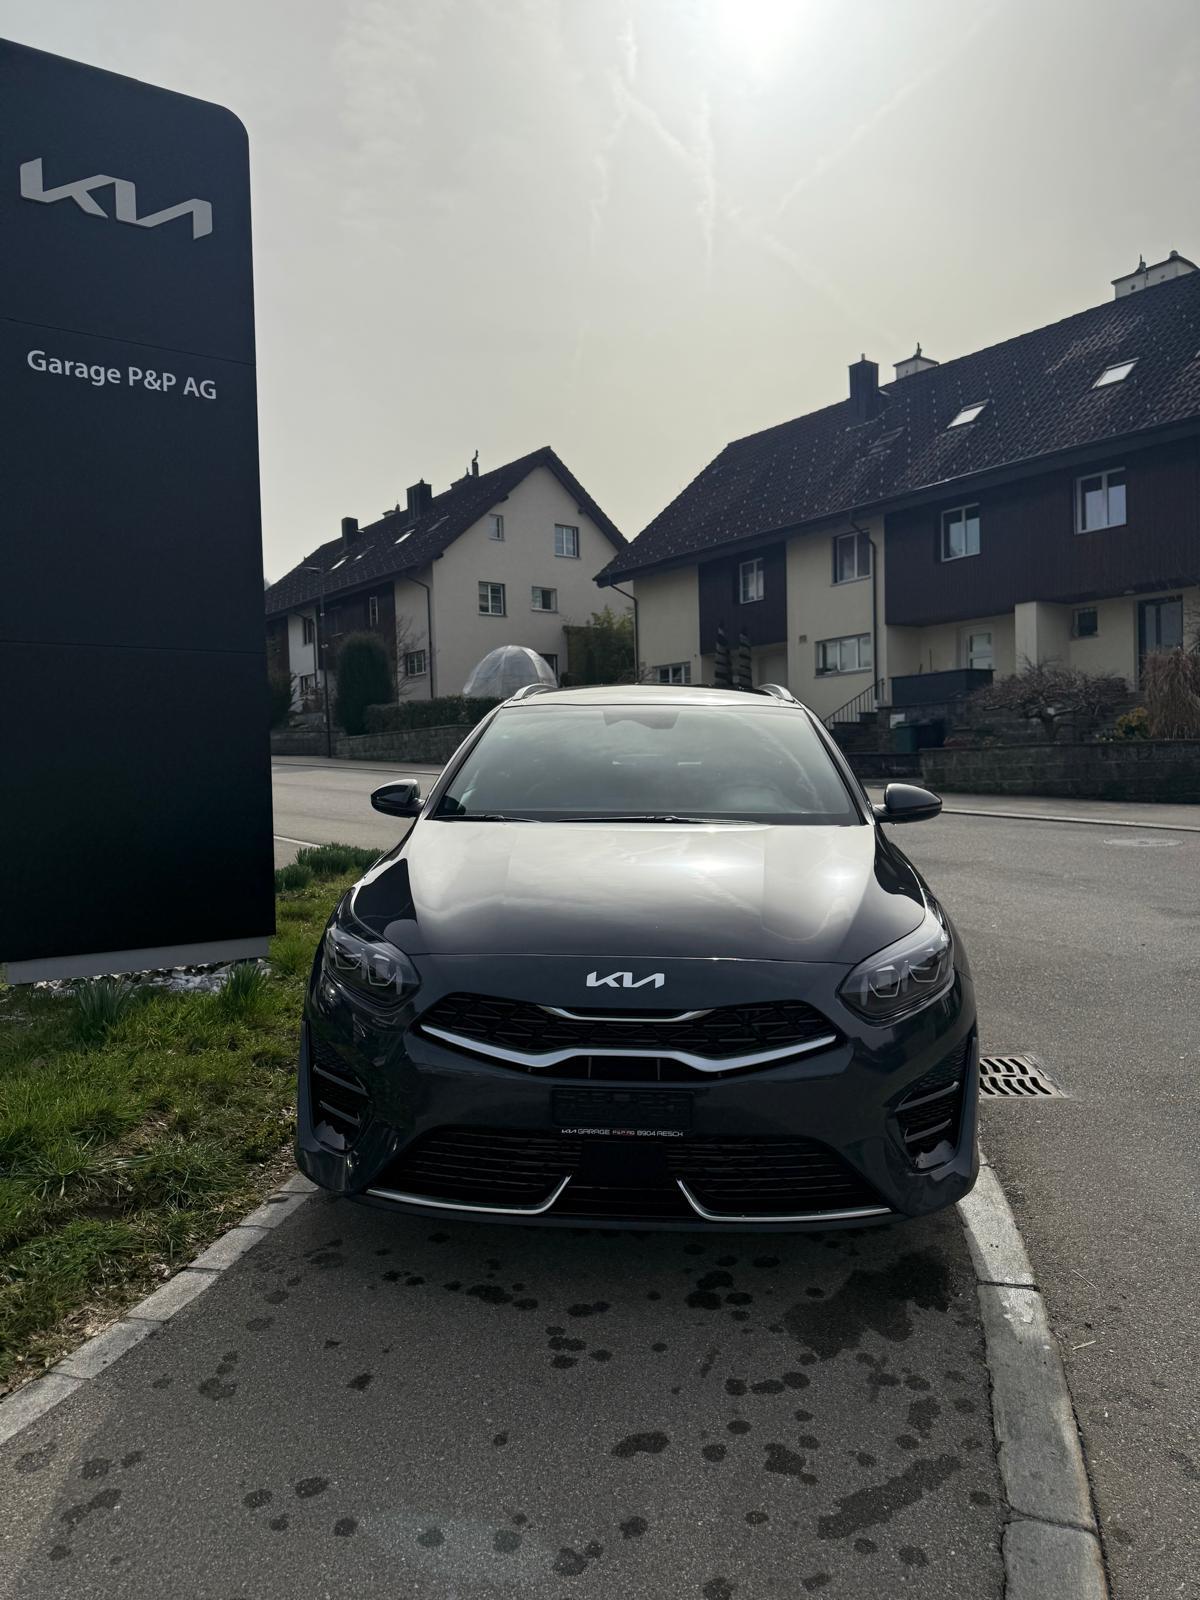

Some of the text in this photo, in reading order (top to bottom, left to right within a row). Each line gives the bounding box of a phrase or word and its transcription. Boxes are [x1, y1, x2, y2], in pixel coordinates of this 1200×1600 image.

[20, 157, 213, 240] KIA
[27, 349, 217, 400] Garage P&P AG
[586, 971, 665, 989] KIA
[577, 1128, 610, 1136] GARAGE
